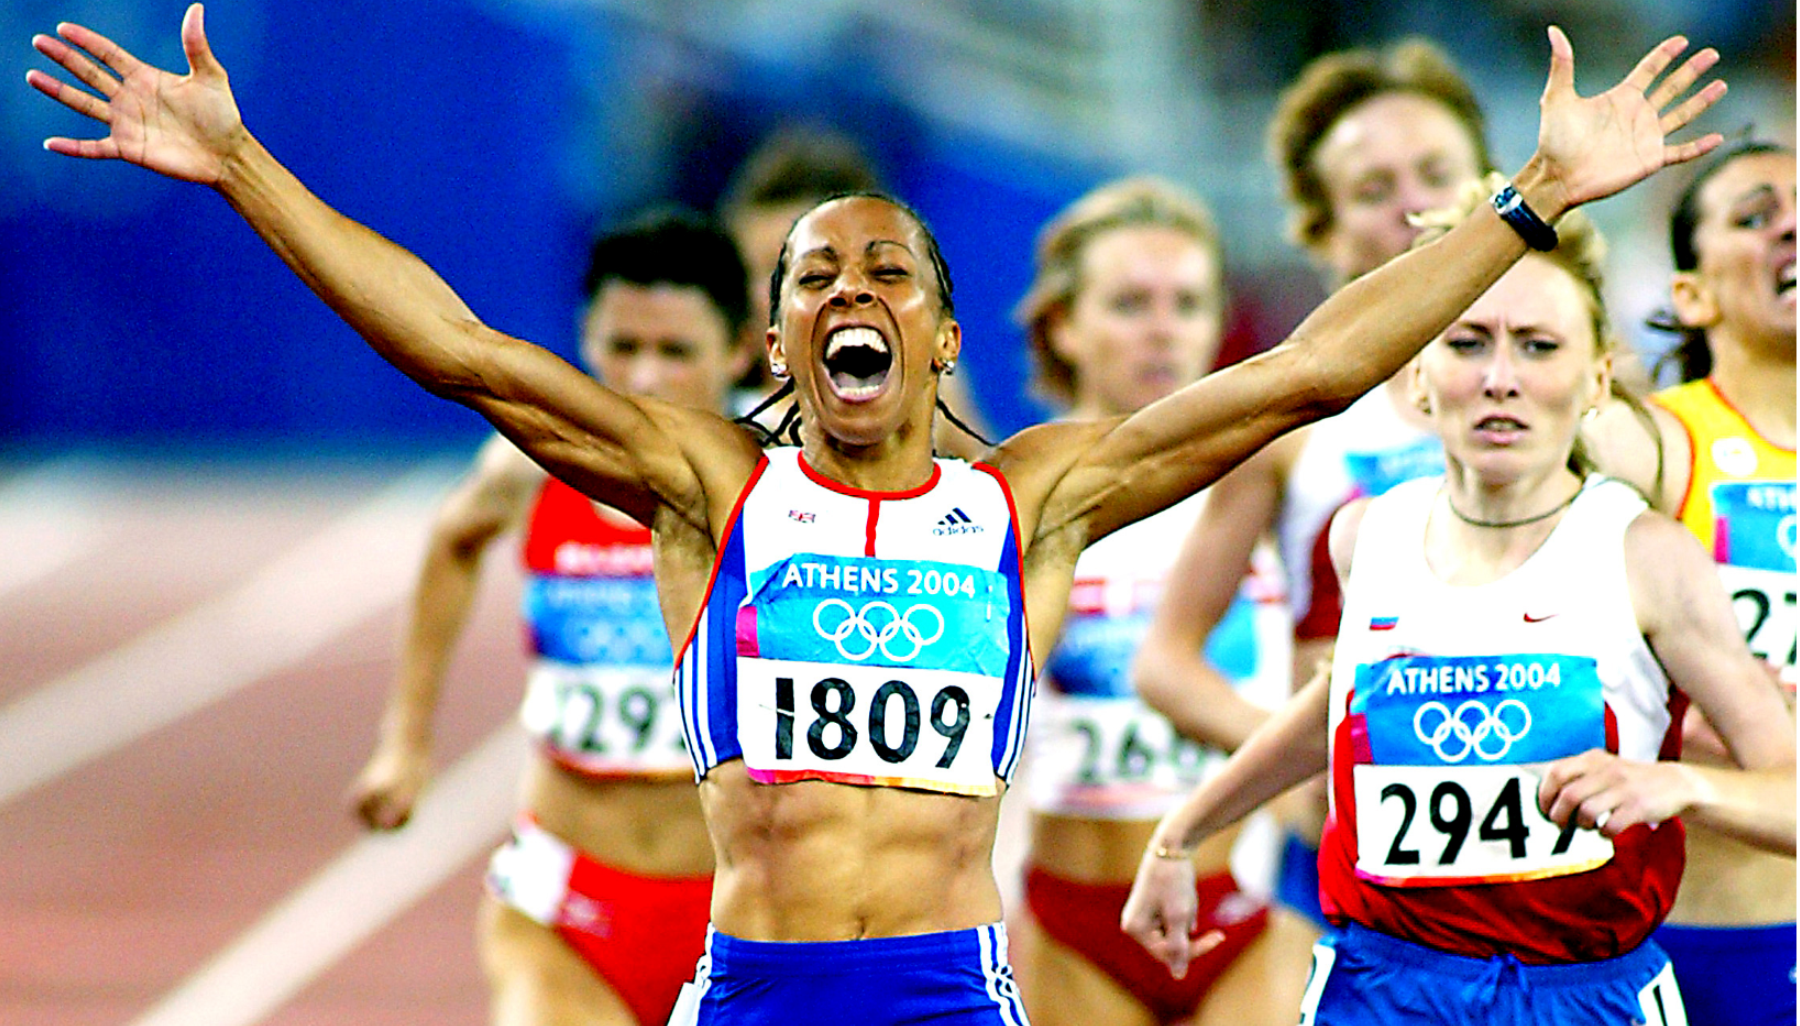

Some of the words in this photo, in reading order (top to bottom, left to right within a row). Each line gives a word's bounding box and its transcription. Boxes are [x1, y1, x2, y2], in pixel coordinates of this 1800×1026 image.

[782, 562, 899, 594] ATHENS
[907, 569, 976, 599] 2004
[1386, 663, 1490, 696] ATHENS
[1494, 662, 1561, 691] 2004
[775, 676, 971, 769] 1809
